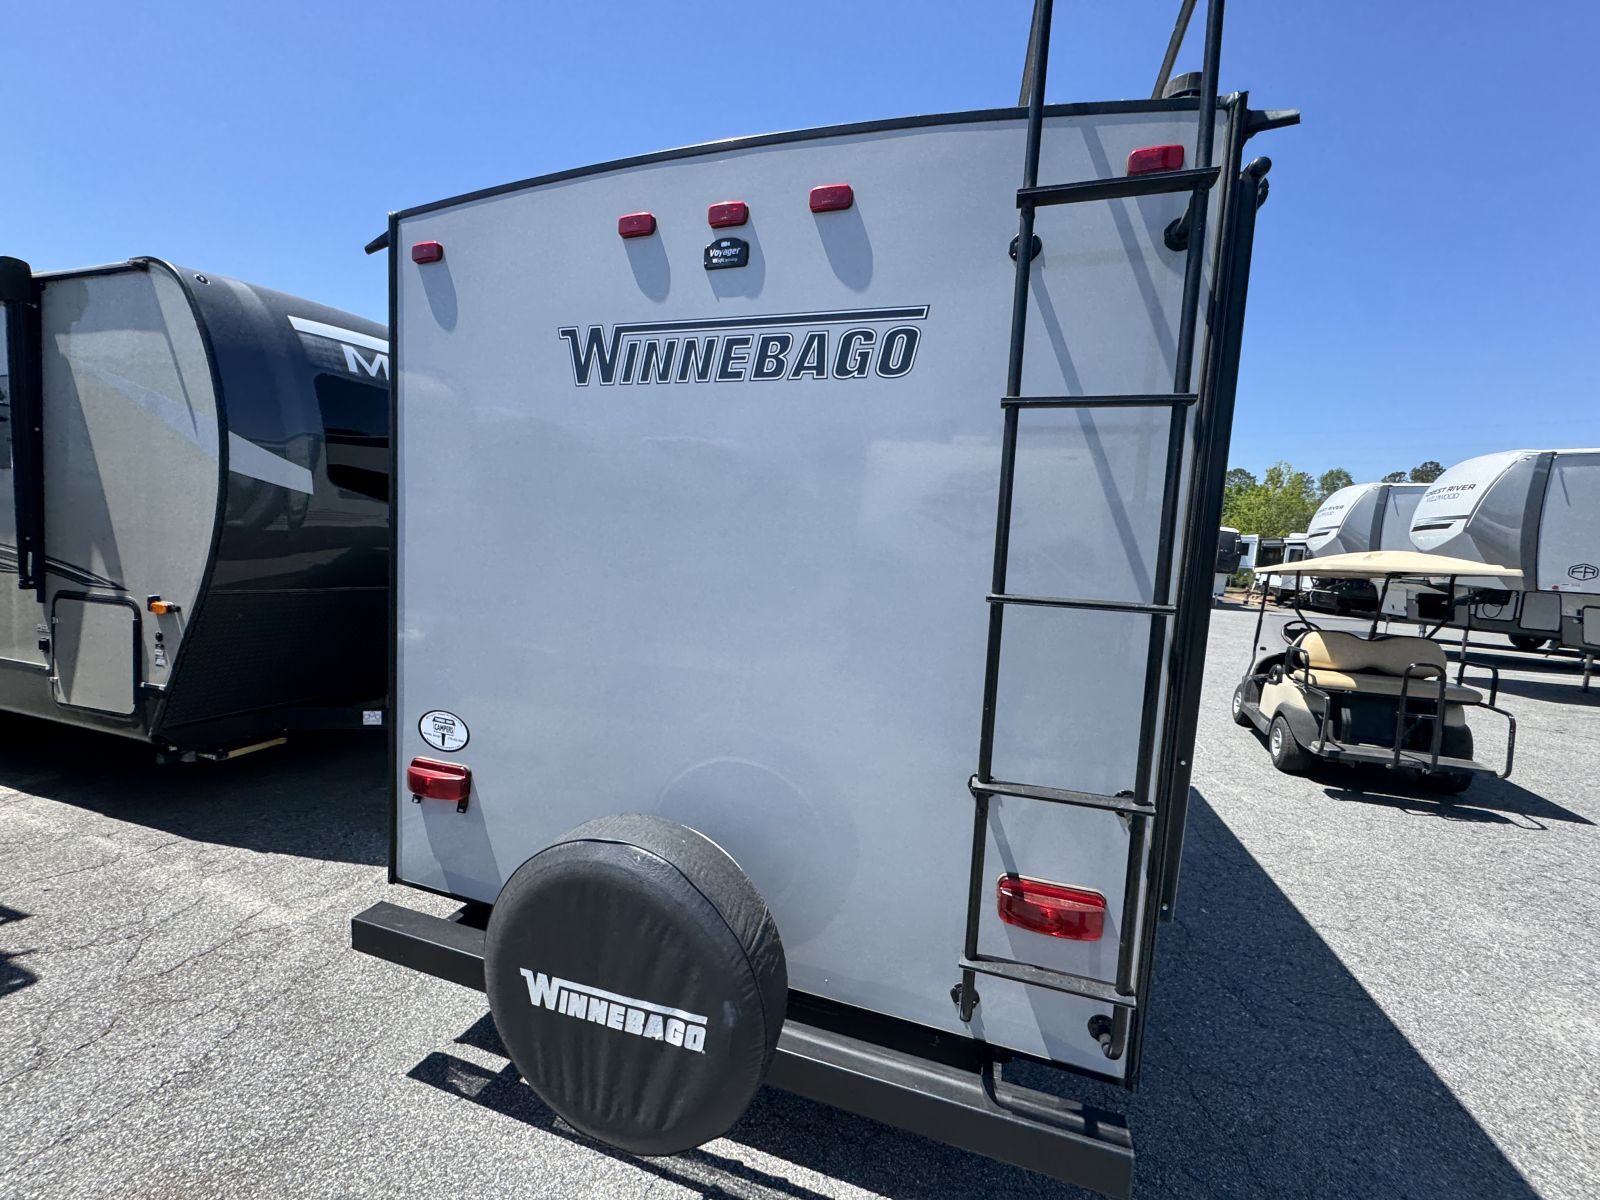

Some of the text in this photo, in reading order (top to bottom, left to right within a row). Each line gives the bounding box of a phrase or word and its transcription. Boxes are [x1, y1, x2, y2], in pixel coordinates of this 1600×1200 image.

[709, 247, 741, 258] Voyager
[558, 304, 931, 387] WINNEBAGO
[1447, 483, 1476, 492] RIVER
[434, 723, 454, 734] CAMPERS
[519, 967, 709, 1054] WINNEBAGO
